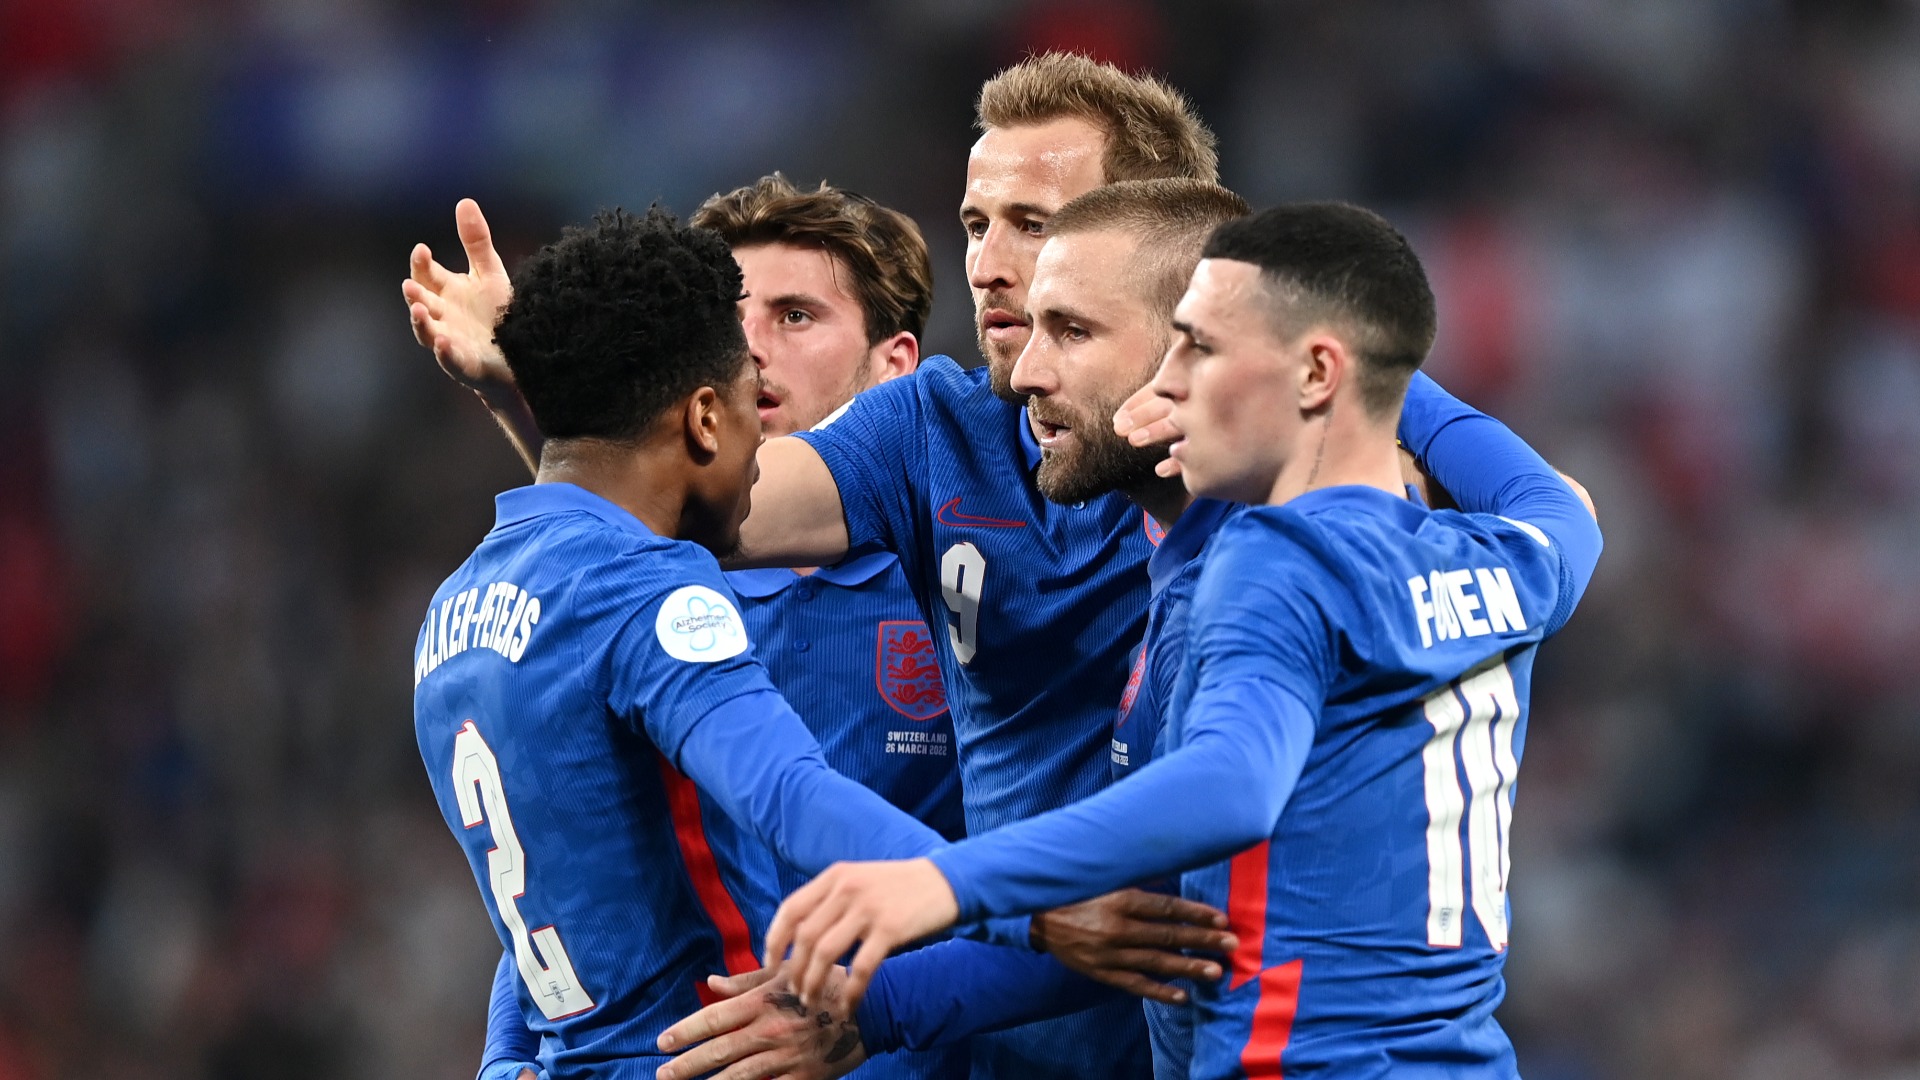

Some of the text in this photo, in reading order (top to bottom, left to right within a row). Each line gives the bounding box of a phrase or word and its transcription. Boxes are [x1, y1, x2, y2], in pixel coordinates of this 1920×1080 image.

[941, 541, 986, 666] 9
[885, 742, 948, 756] 26 MARCH 2022
[887, 731, 948, 743] SWITZERLAND
[1421, 653, 1520, 952] 10
[452, 719, 597, 1021] 2
